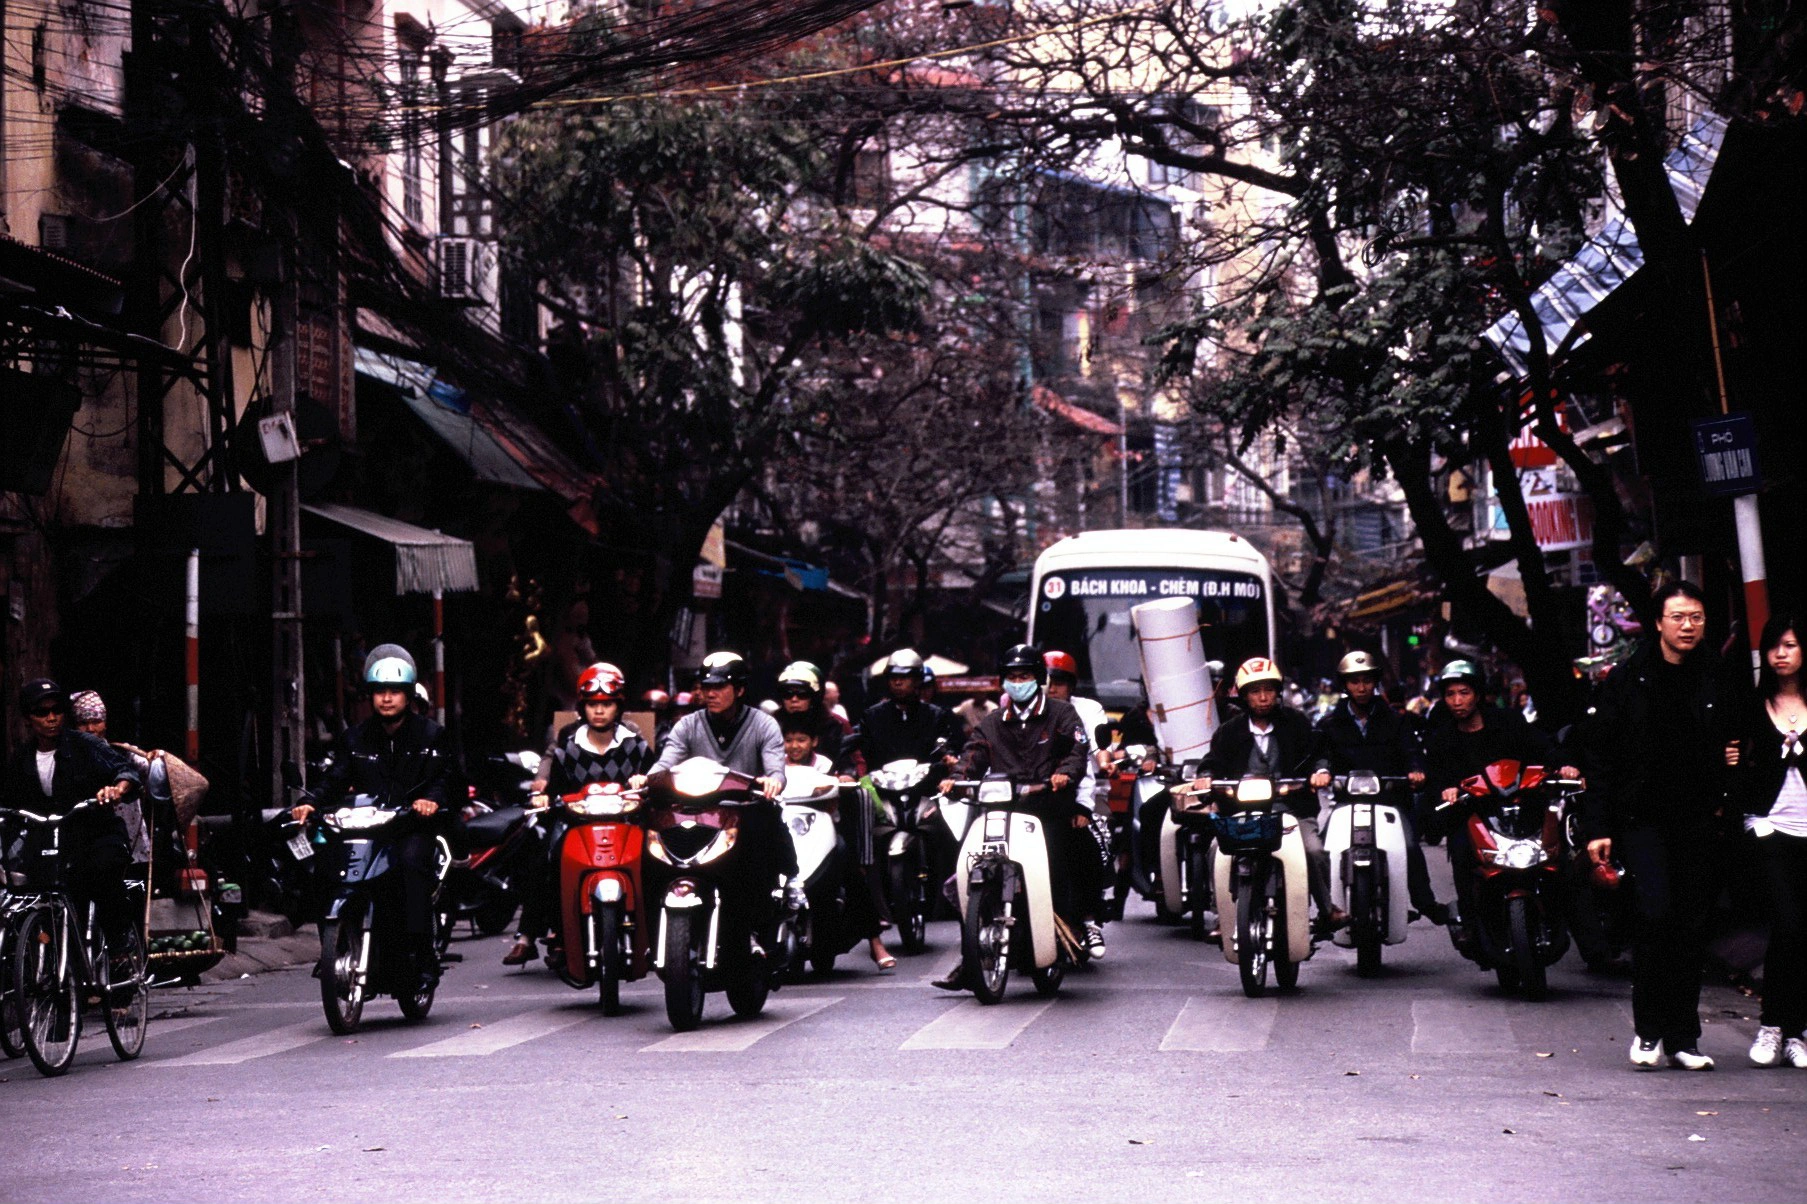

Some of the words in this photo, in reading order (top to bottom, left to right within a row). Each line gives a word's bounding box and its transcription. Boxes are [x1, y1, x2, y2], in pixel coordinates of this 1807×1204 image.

[1047, 581, 1061, 593] 31
[1071, 576, 1107, 595] BÁCH
[1110, 579, 1147, 595] KHOA
